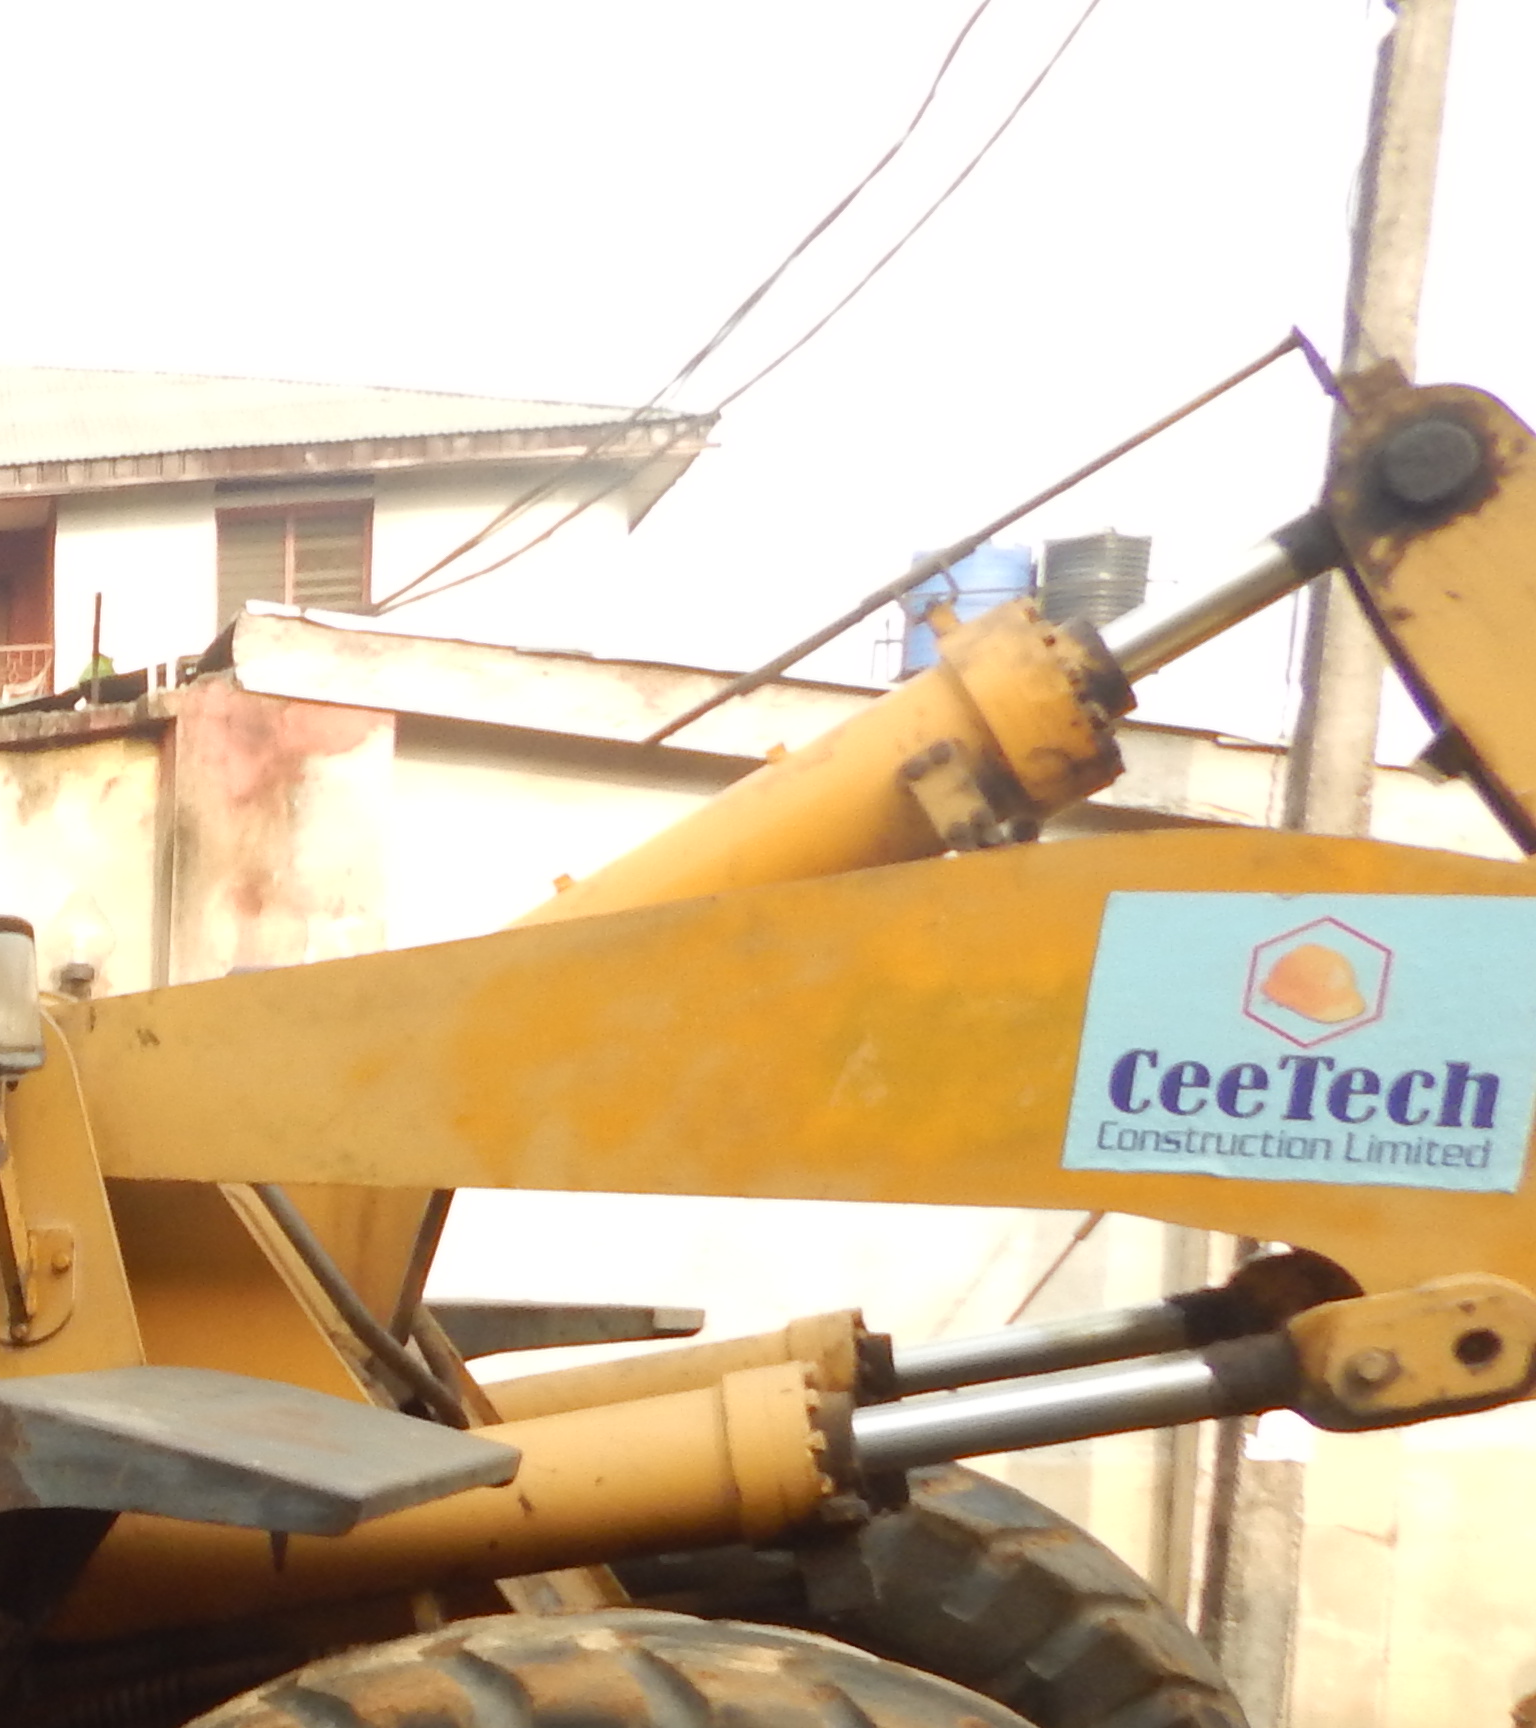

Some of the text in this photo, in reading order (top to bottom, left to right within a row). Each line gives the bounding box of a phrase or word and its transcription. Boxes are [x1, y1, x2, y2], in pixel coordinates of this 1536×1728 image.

[1108, 1047, 1501, 1129] CeeTech
[1096, 1119, 1492, 1169] Construction Limited
